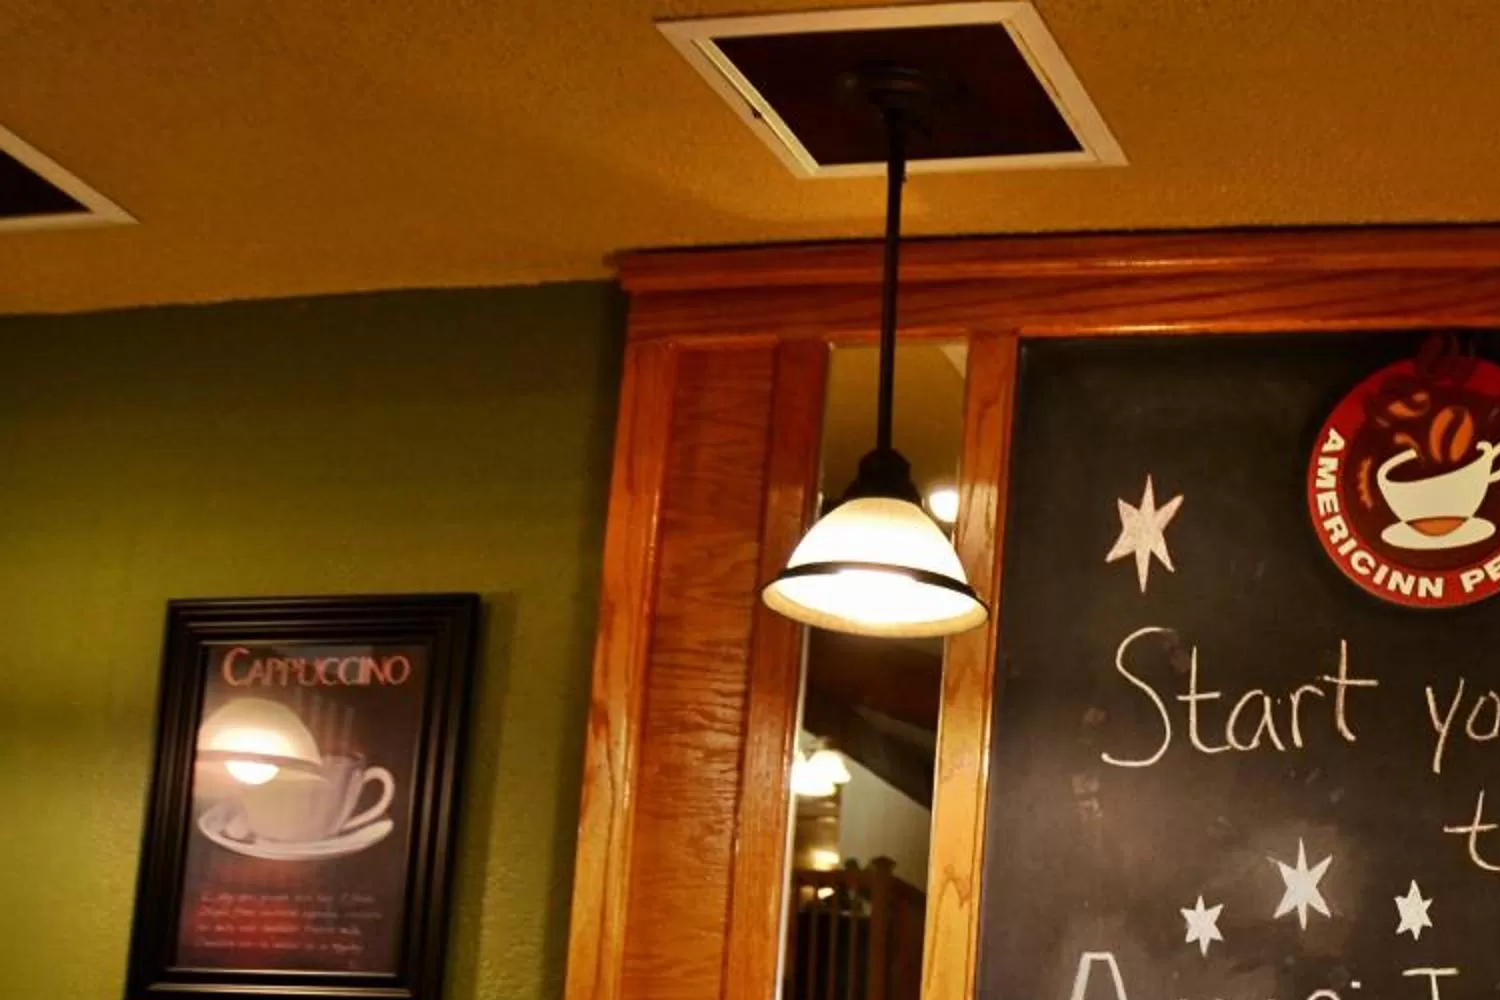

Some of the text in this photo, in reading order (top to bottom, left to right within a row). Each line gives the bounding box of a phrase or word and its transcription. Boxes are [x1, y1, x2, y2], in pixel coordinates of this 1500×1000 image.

[1315, 428, 1444, 599] AMERICINN
[223, 647, 411, 687] CAPPUCCINO
[1101, 626, 1379, 768] Start
